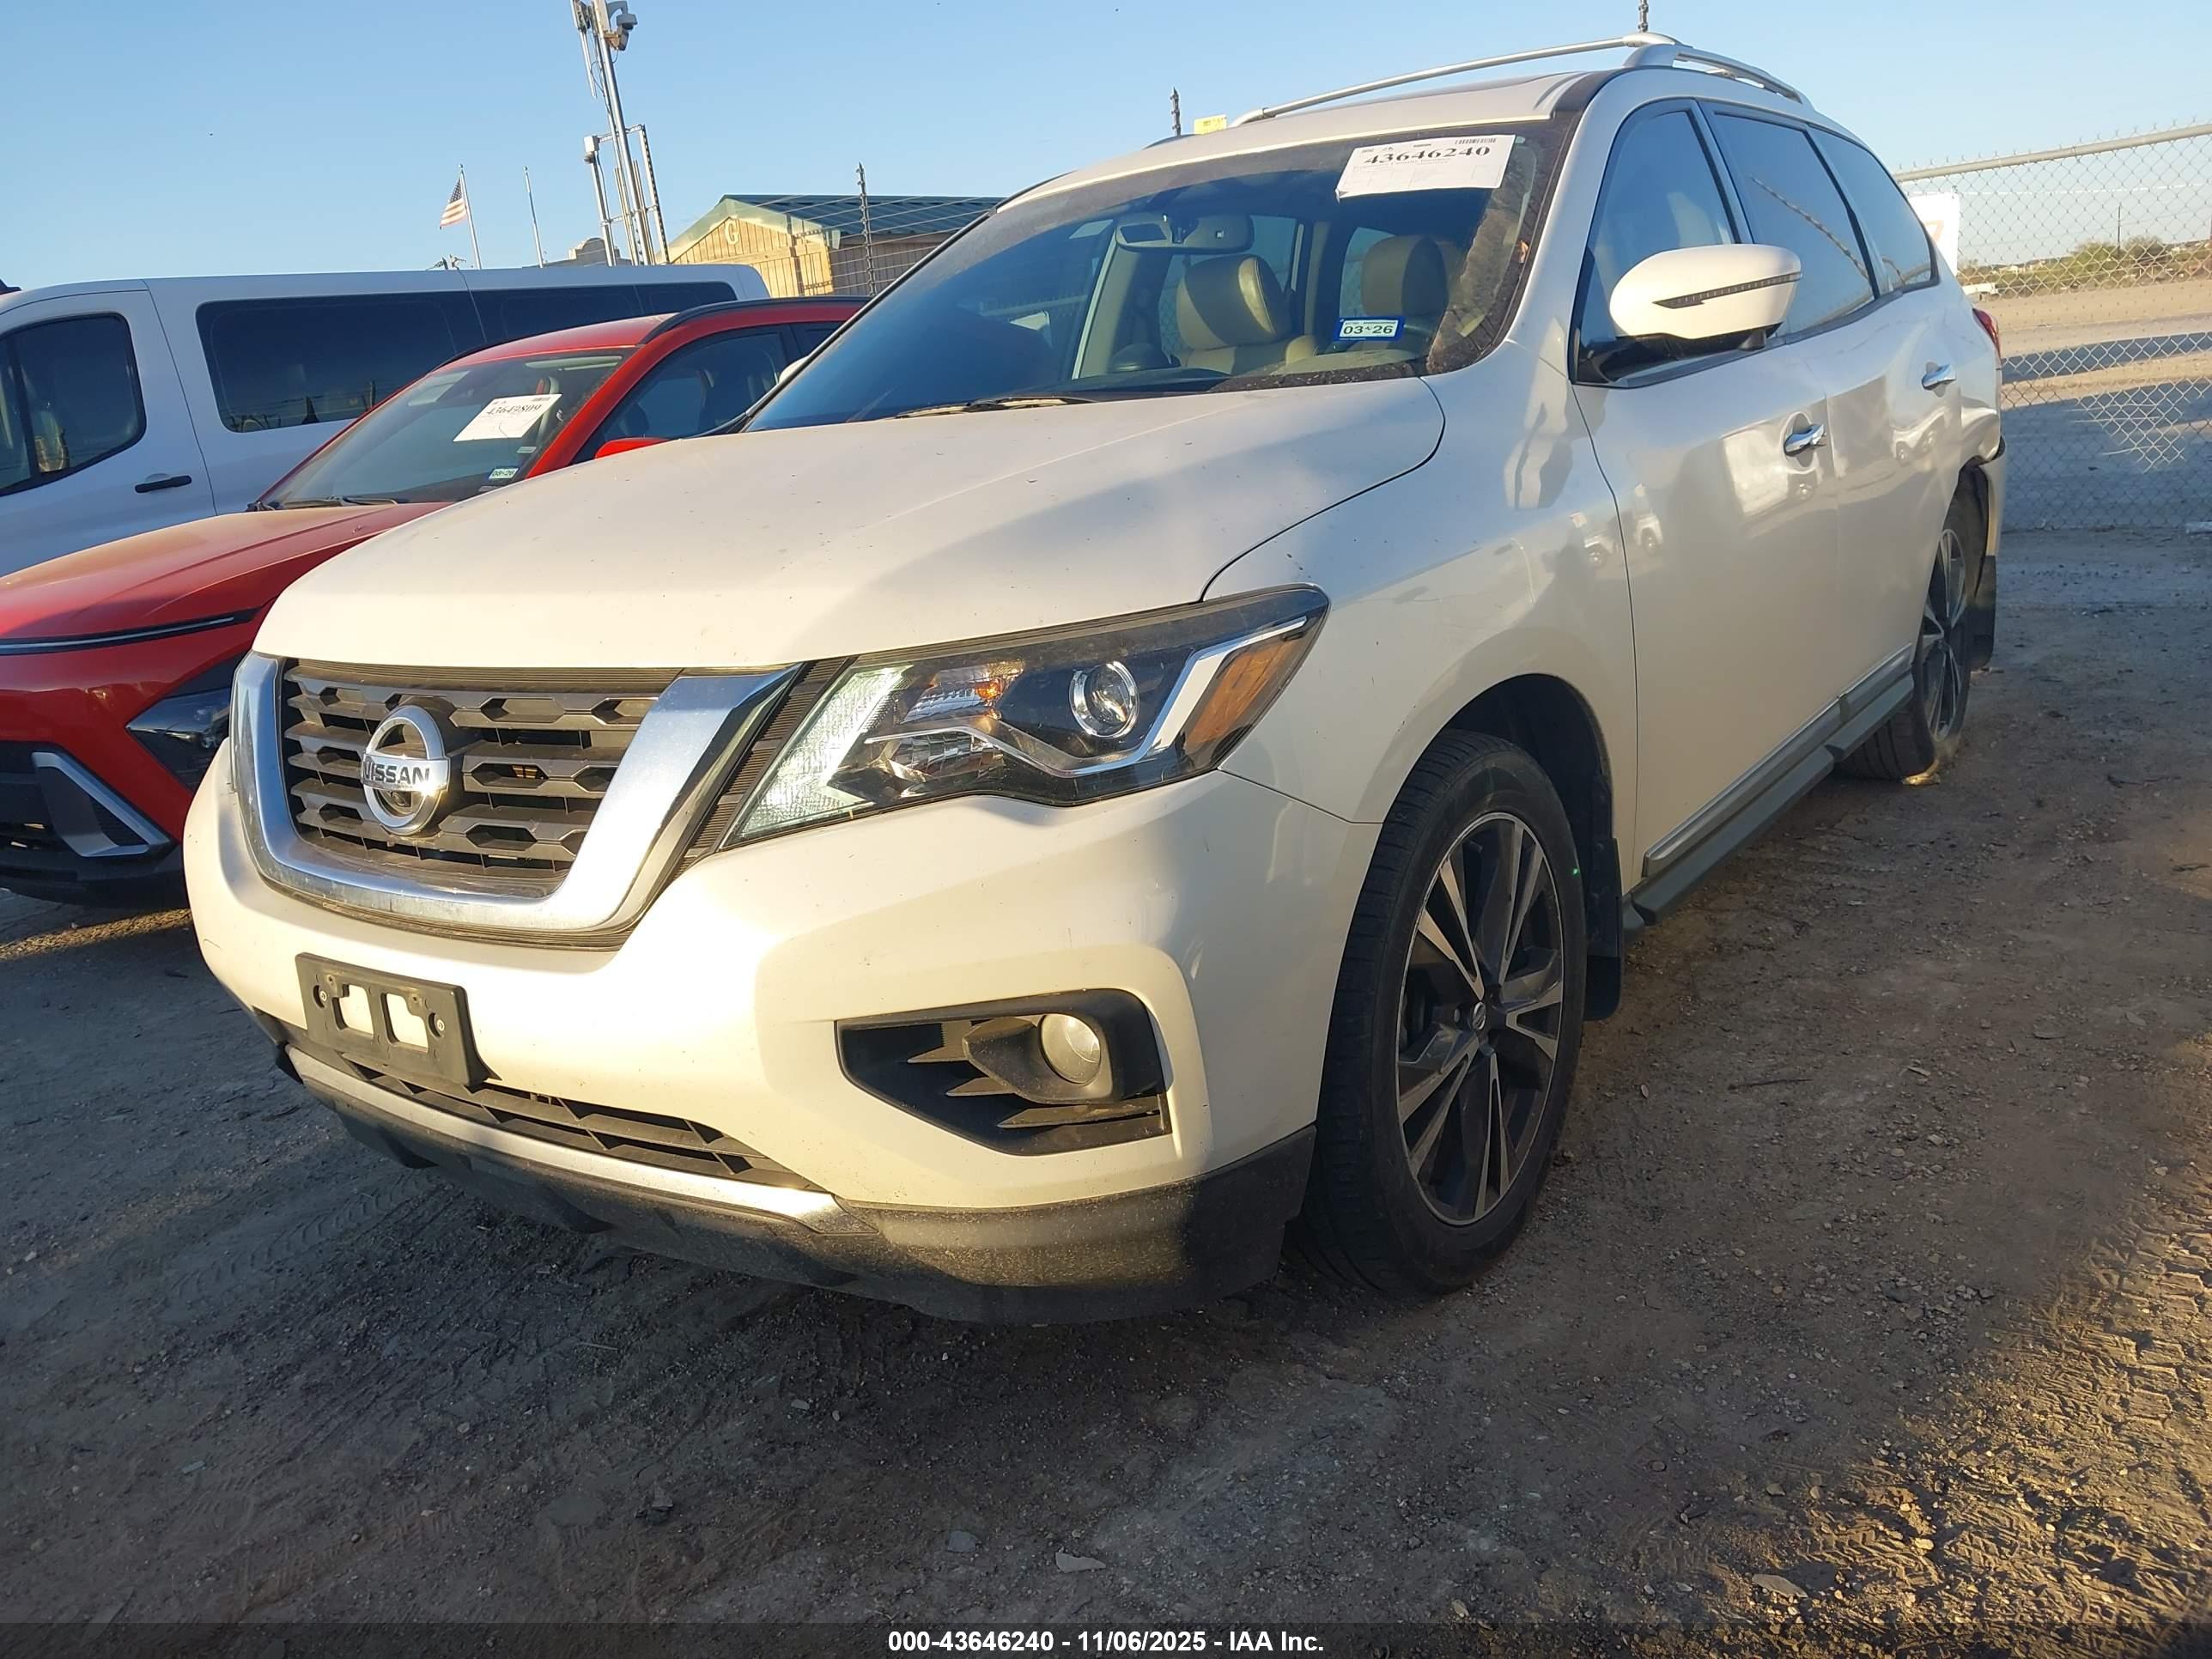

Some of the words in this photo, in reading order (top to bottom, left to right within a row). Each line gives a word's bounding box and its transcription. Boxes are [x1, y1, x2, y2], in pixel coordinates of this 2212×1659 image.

[1364, 146, 1491, 164] 43646240
[725, 221, 739, 245] G
[363, 756, 430, 785] NISSAN
